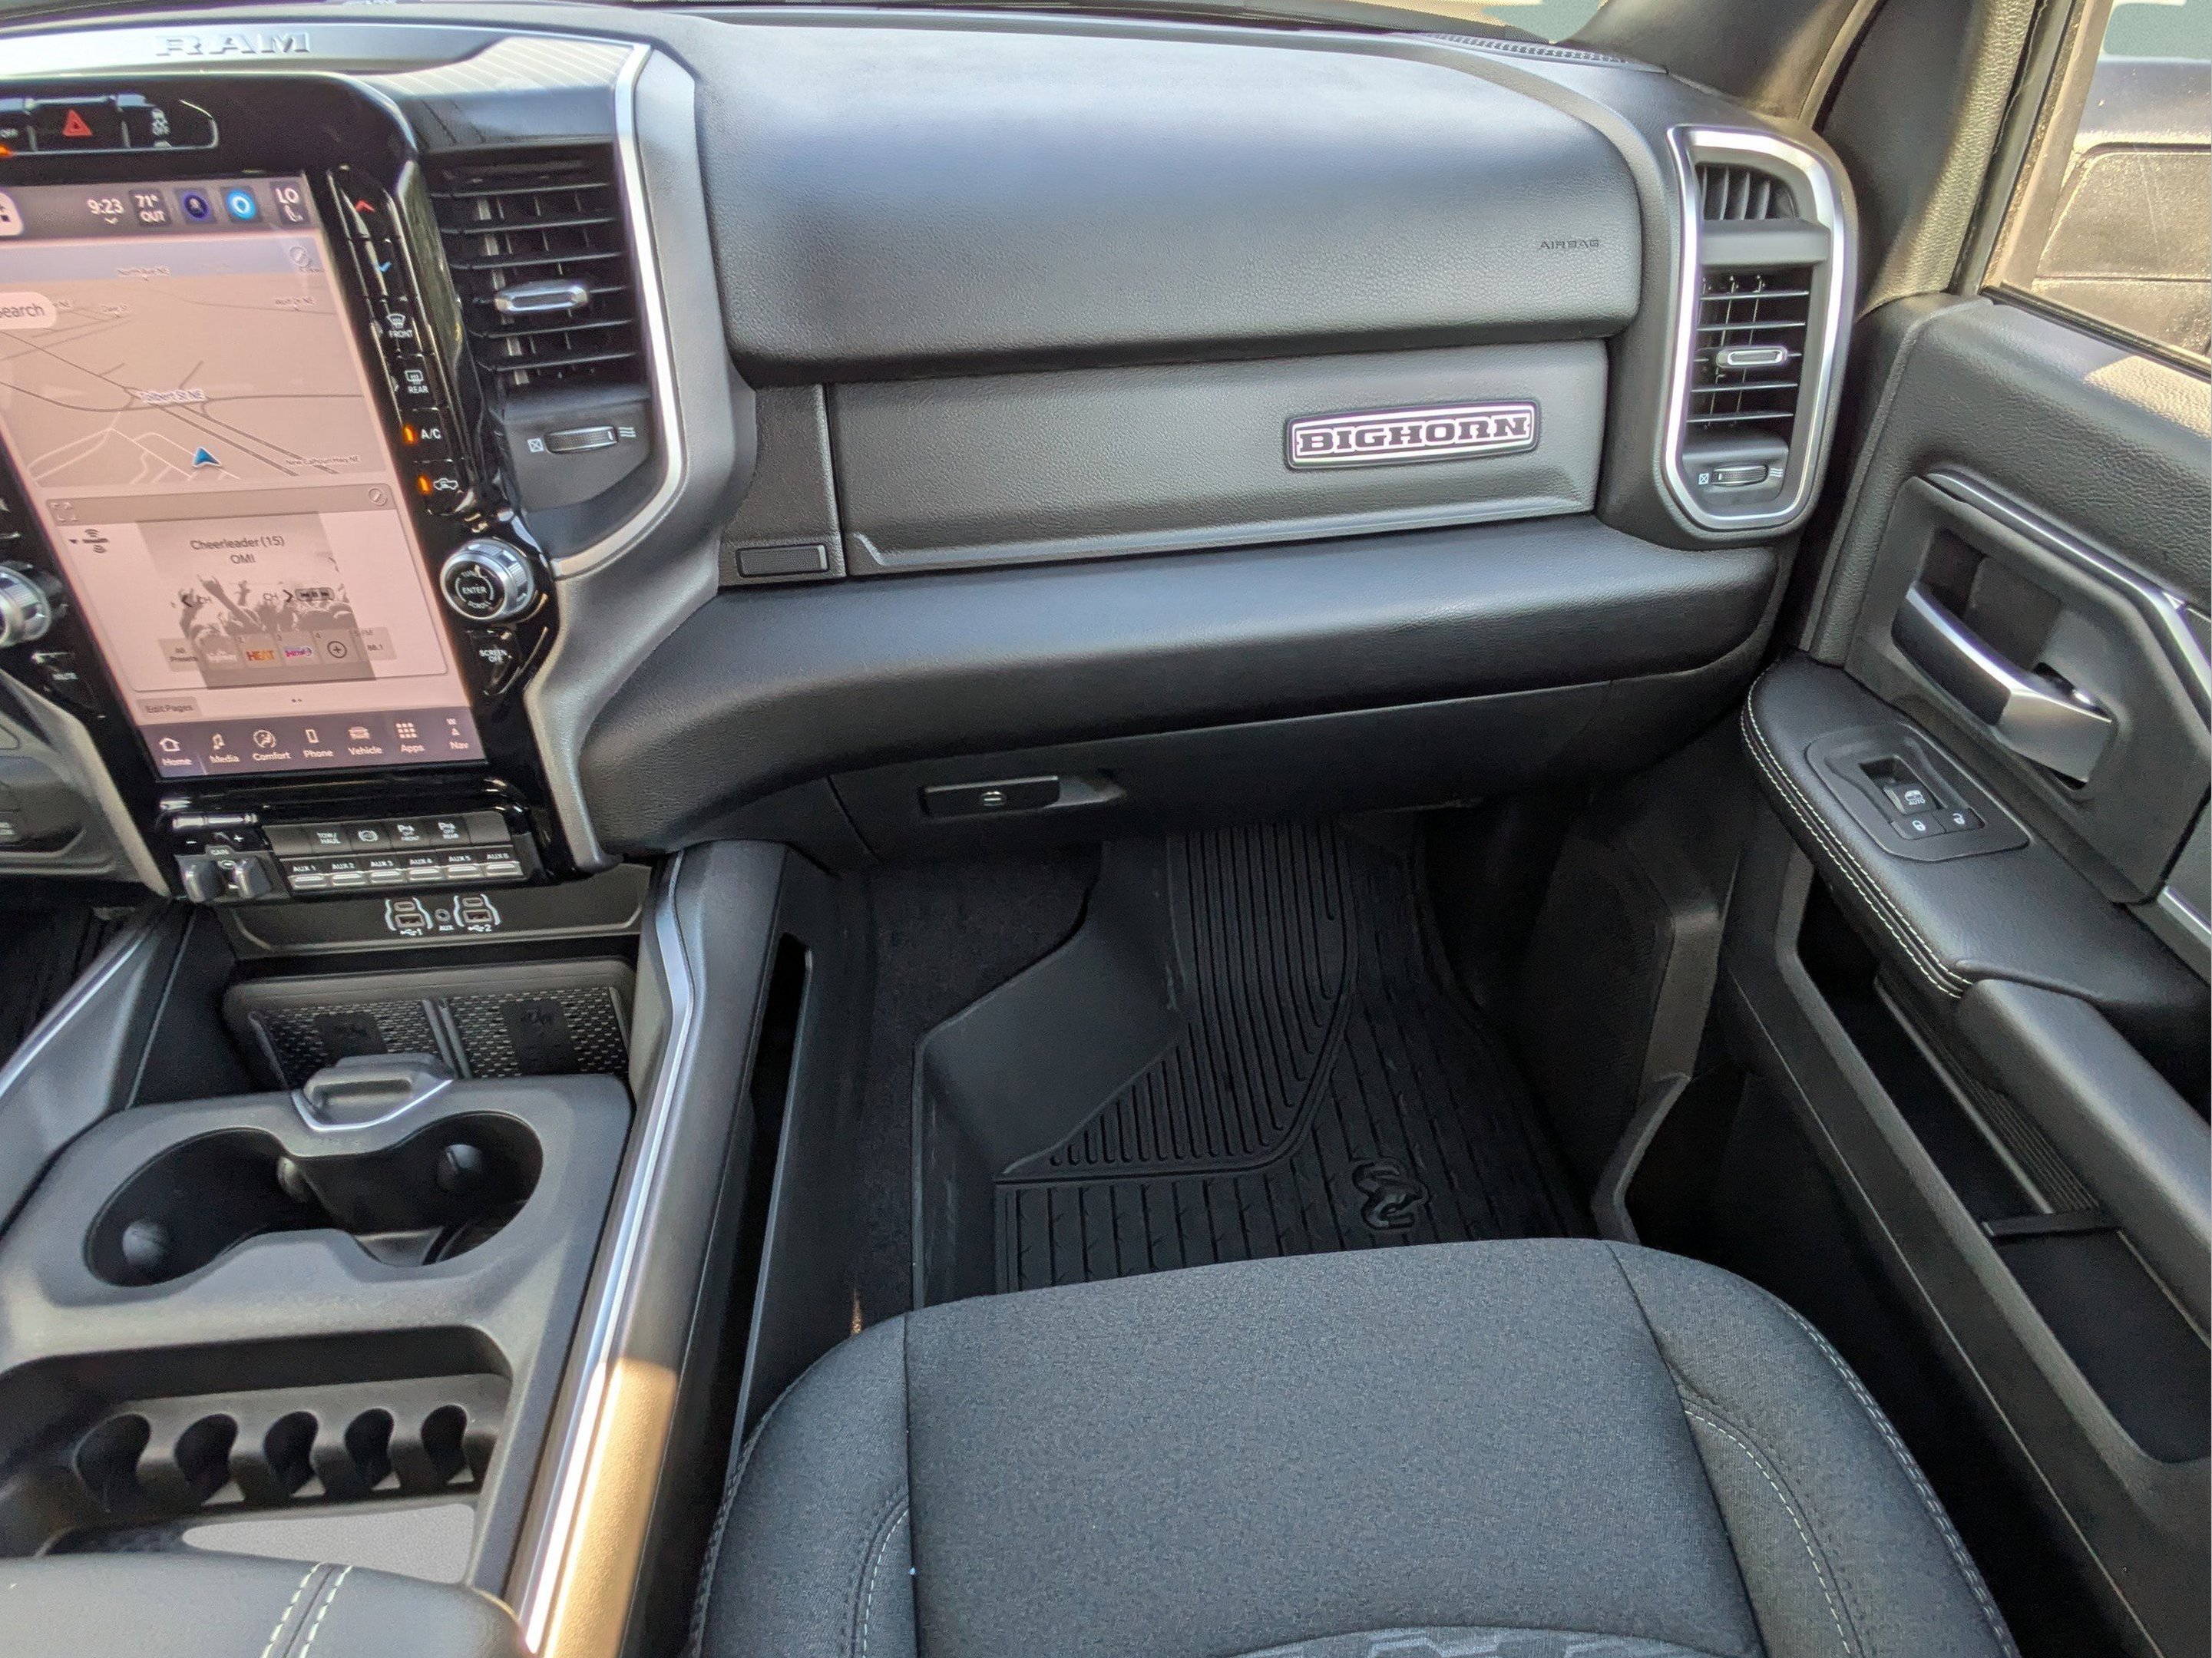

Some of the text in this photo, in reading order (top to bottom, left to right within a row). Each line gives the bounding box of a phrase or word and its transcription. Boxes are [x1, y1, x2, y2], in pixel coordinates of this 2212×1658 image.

[155, 32, 309, 57] RAM
[275, 187, 299, 204] LO
[87, 197, 124, 215] 9:23
[140, 210, 165, 223] OUT
[1539, 239, 1599, 249] AIRBAG
[389, 329, 413, 339] FRONT
[408, 385, 429, 394] REAR
[421, 428, 442, 440] A/C
[1298, 416, 1528, 454] BIGHORN
[190, 536, 285, 550] Cheerleader (15)
[230, 553, 256, 564] OMI
[461, 586, 488, 595] ENTER
[263, 592, 279, 601] CH
[145, 704, 193, 714] Edit Pages
[348, 745, 382, 756] Vehicle
[400, 744, 425, 754] Apps
[450, 741, 469, 750] Nav
[210, 753, 240, 764] Media
[252, 751, 292, 762] Comfort
[303, 749, 334, 758] Phone
[162, 758, 192, 766] Home
